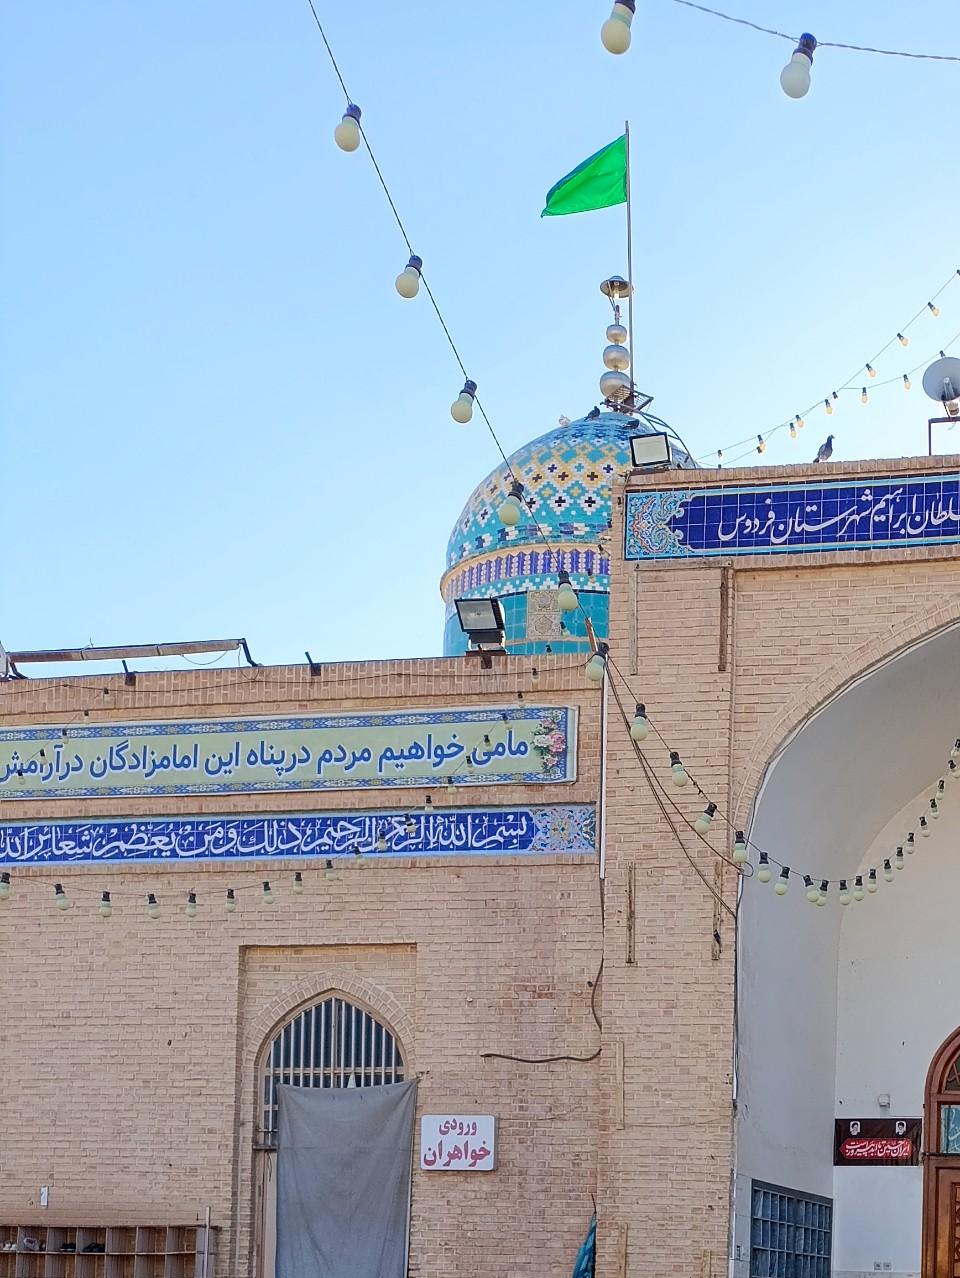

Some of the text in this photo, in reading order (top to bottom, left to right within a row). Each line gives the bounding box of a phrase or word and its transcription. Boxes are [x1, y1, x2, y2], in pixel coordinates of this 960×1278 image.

[718, 498, 775, 541] فردوس
[771, 488, 875, 544] شهرستان
[870, 487, 917, 539] ابراهیم
[90, 740, 198, 778] امامزادگان
[205, 742, 239, 775] این
[317, 744, 371, 774] مردم
[439, 1118, 477, 1135] ورودی
[423, 1140, 491, 1167] خواهران
